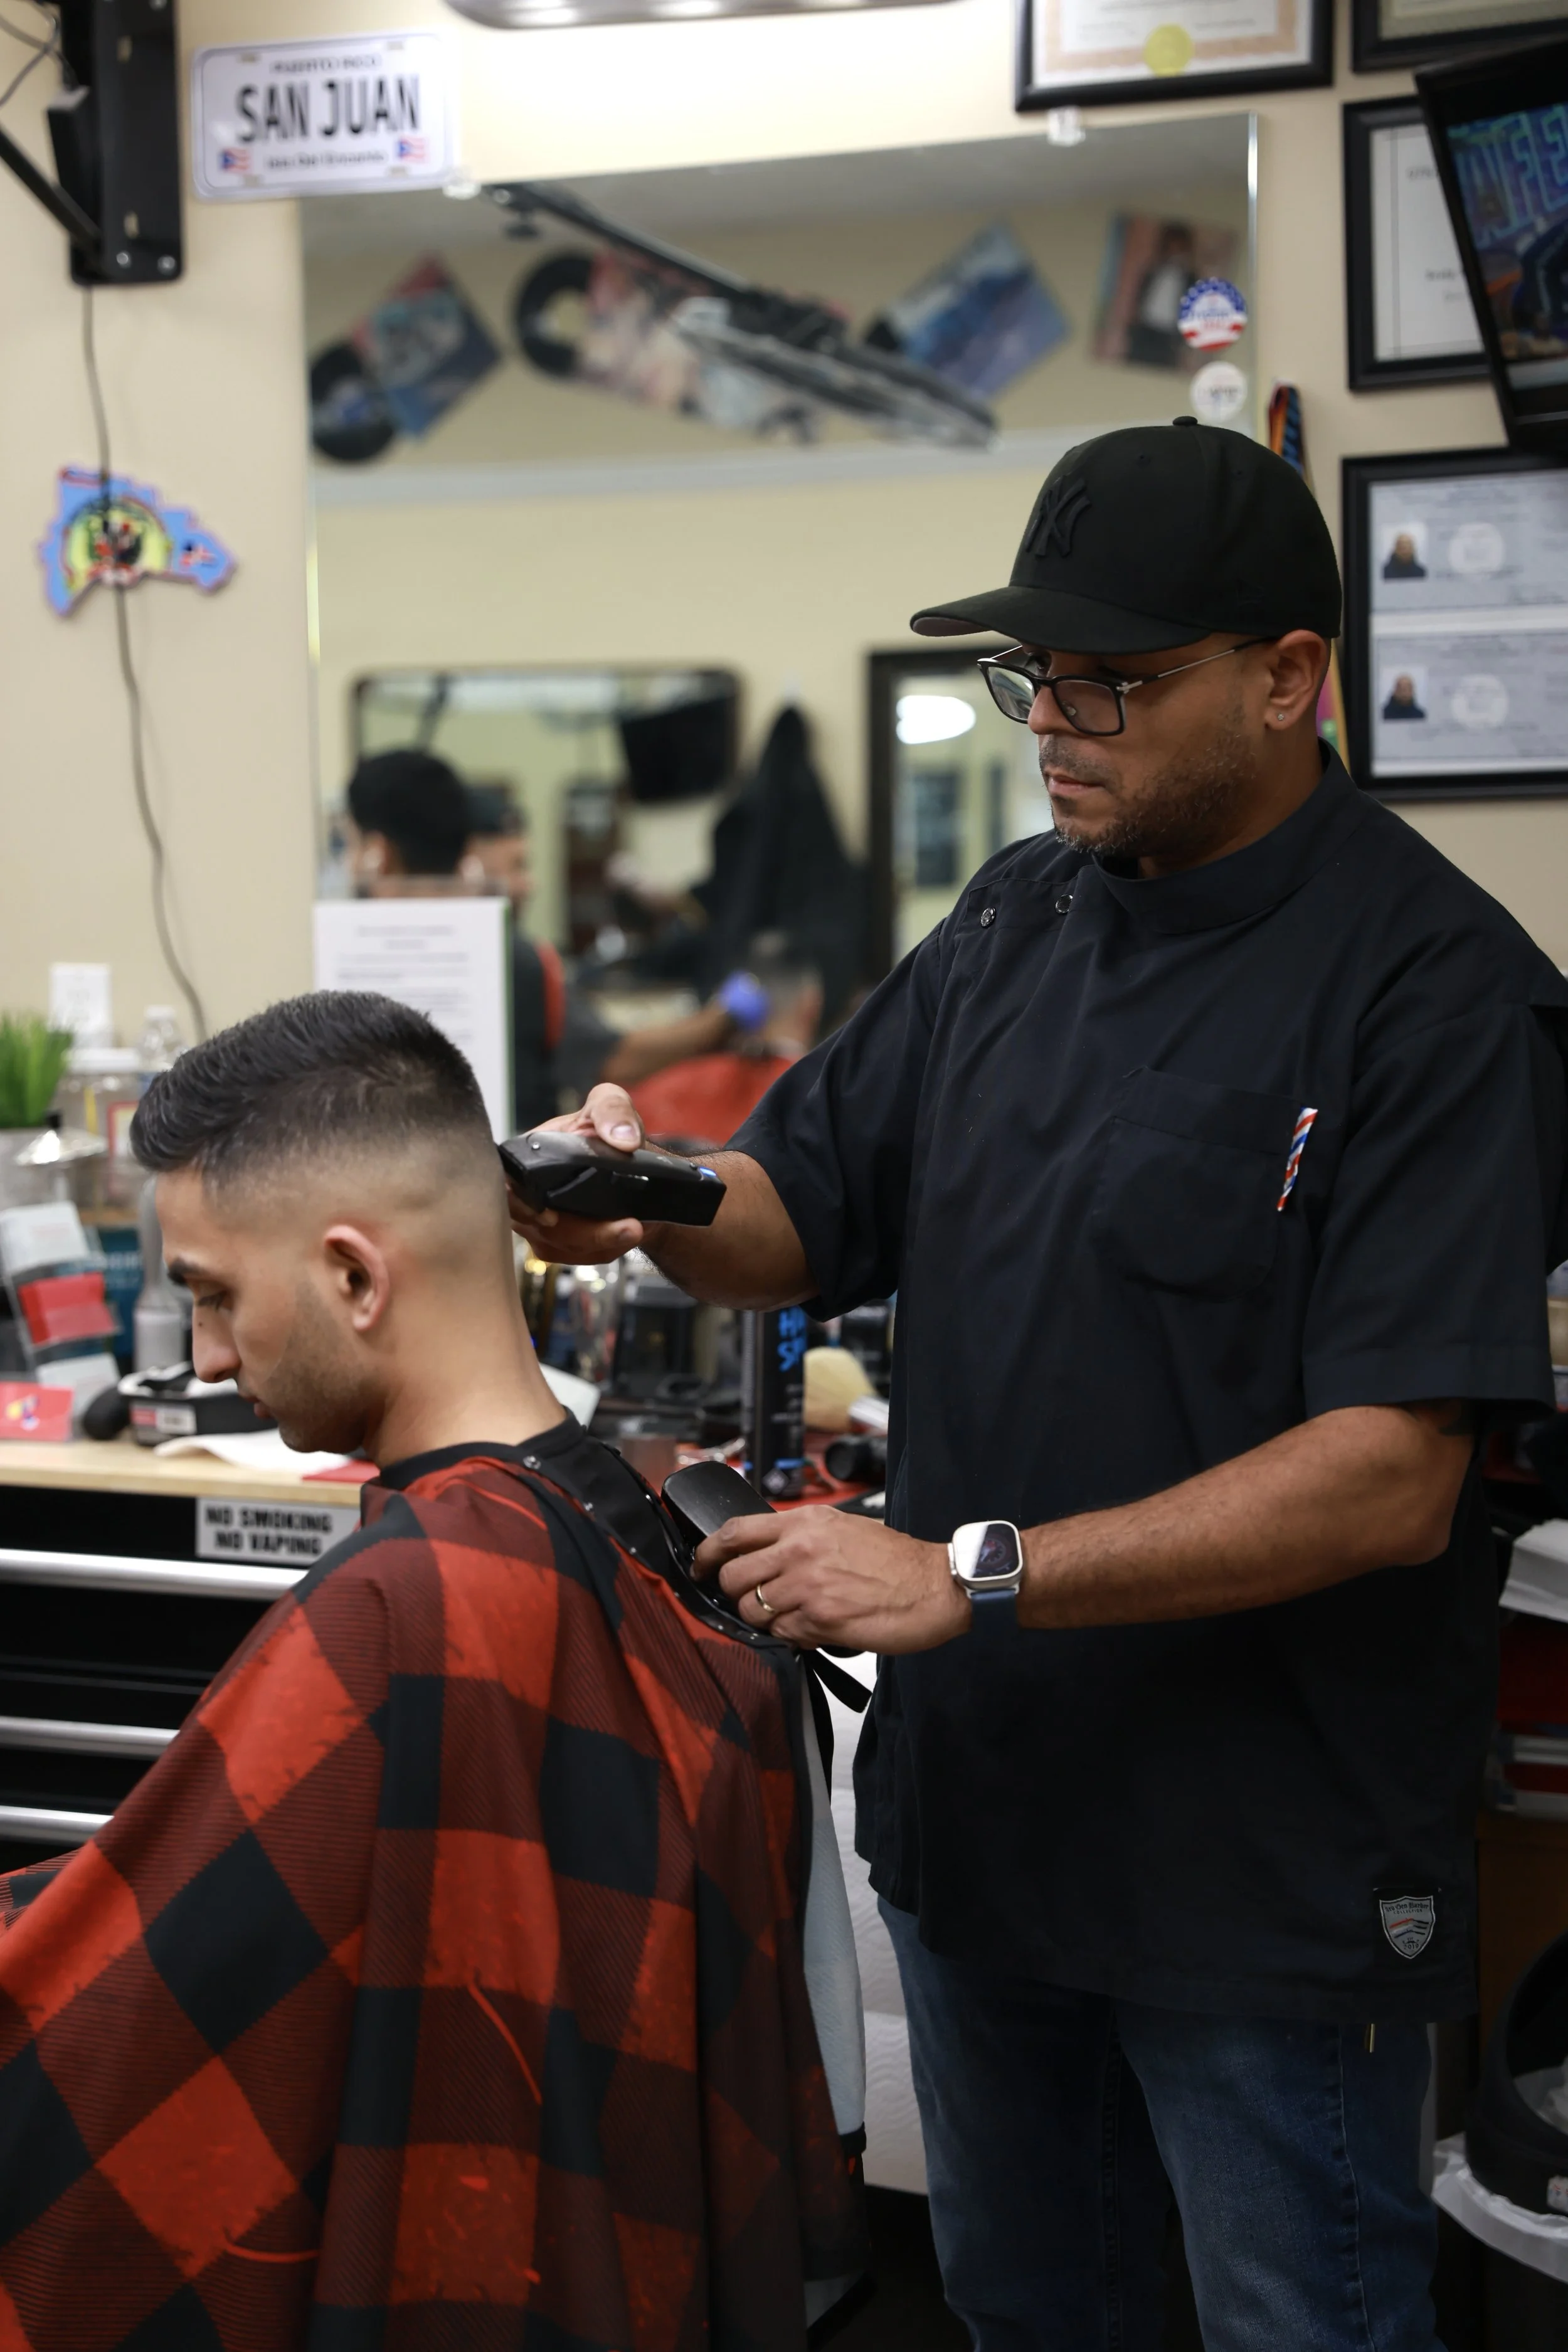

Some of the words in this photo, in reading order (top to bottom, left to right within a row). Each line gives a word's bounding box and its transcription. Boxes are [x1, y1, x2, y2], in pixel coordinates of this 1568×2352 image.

[235, 79, 309, 143] SAN
[319, 73, 420, 136] JUAN
[1024, 474, 1092, 558] NY
[206, 1507, 233, 1525] NO
[240, 1509, 332, 1532] SMOKING
[216, 1532, 242, 1550] NO
[249, 1534, 322, 1555] VAPING
